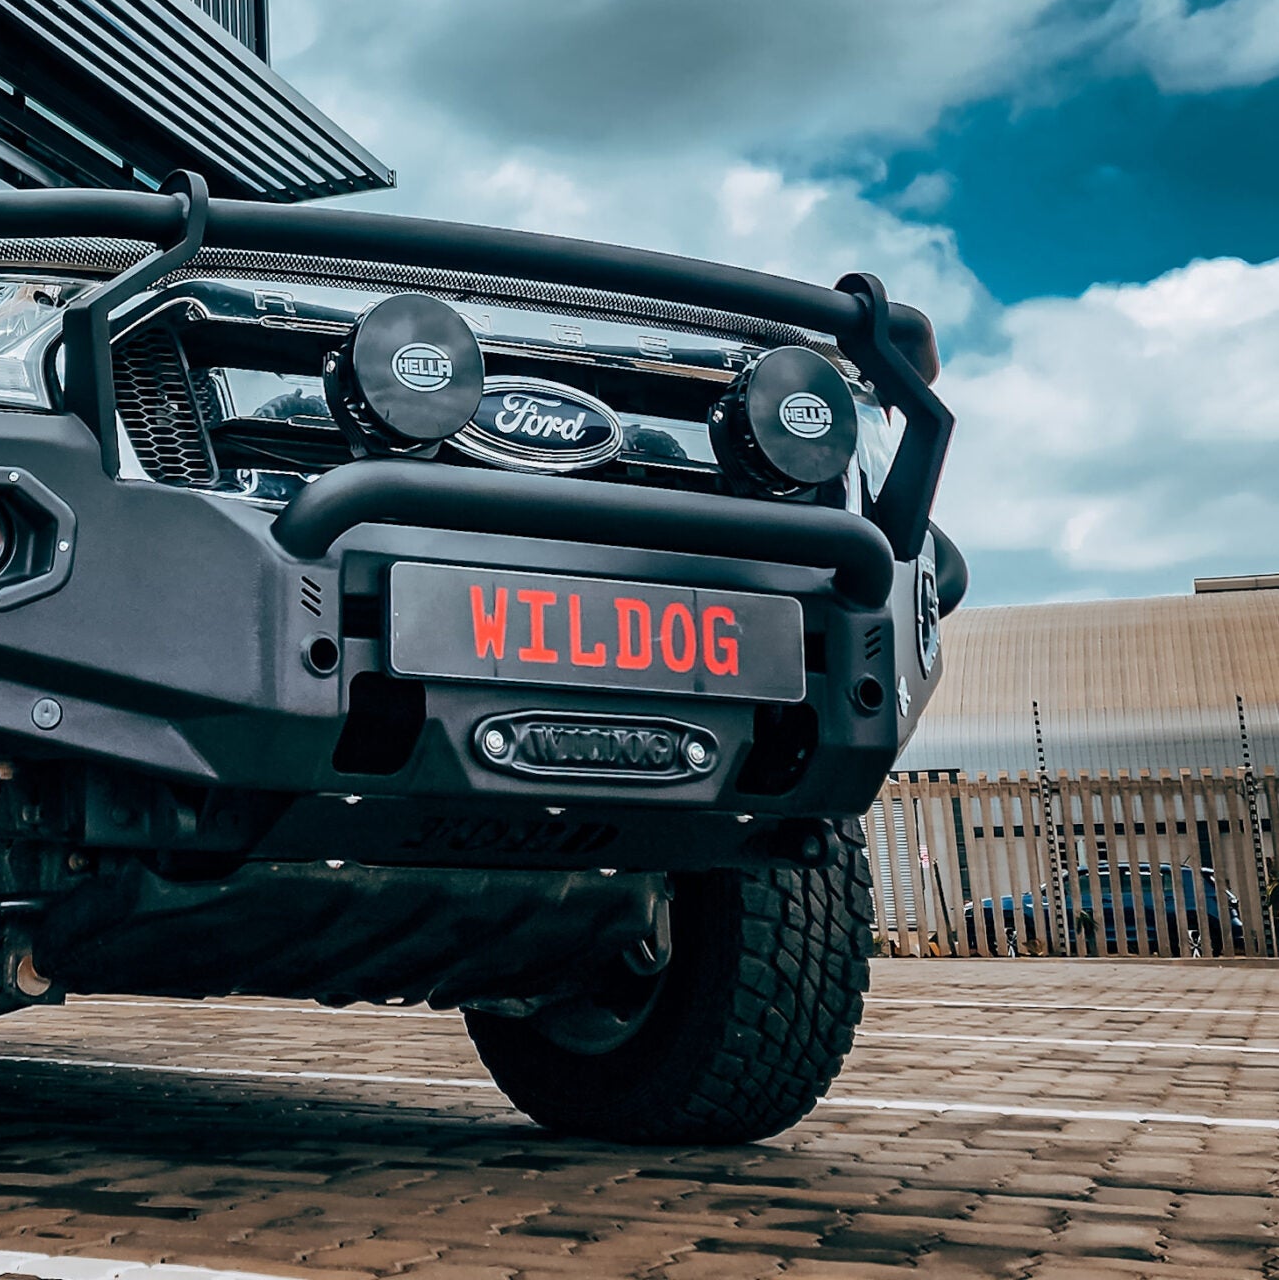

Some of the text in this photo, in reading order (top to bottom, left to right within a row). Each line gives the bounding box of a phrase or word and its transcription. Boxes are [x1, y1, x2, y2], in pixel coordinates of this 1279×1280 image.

[395, 356, 453, 379] HELLA
[493, 392, 587, 443] Ford
[782, 403, 832, 426] HELLA
[469, 585, 740, 676] WILDOG
